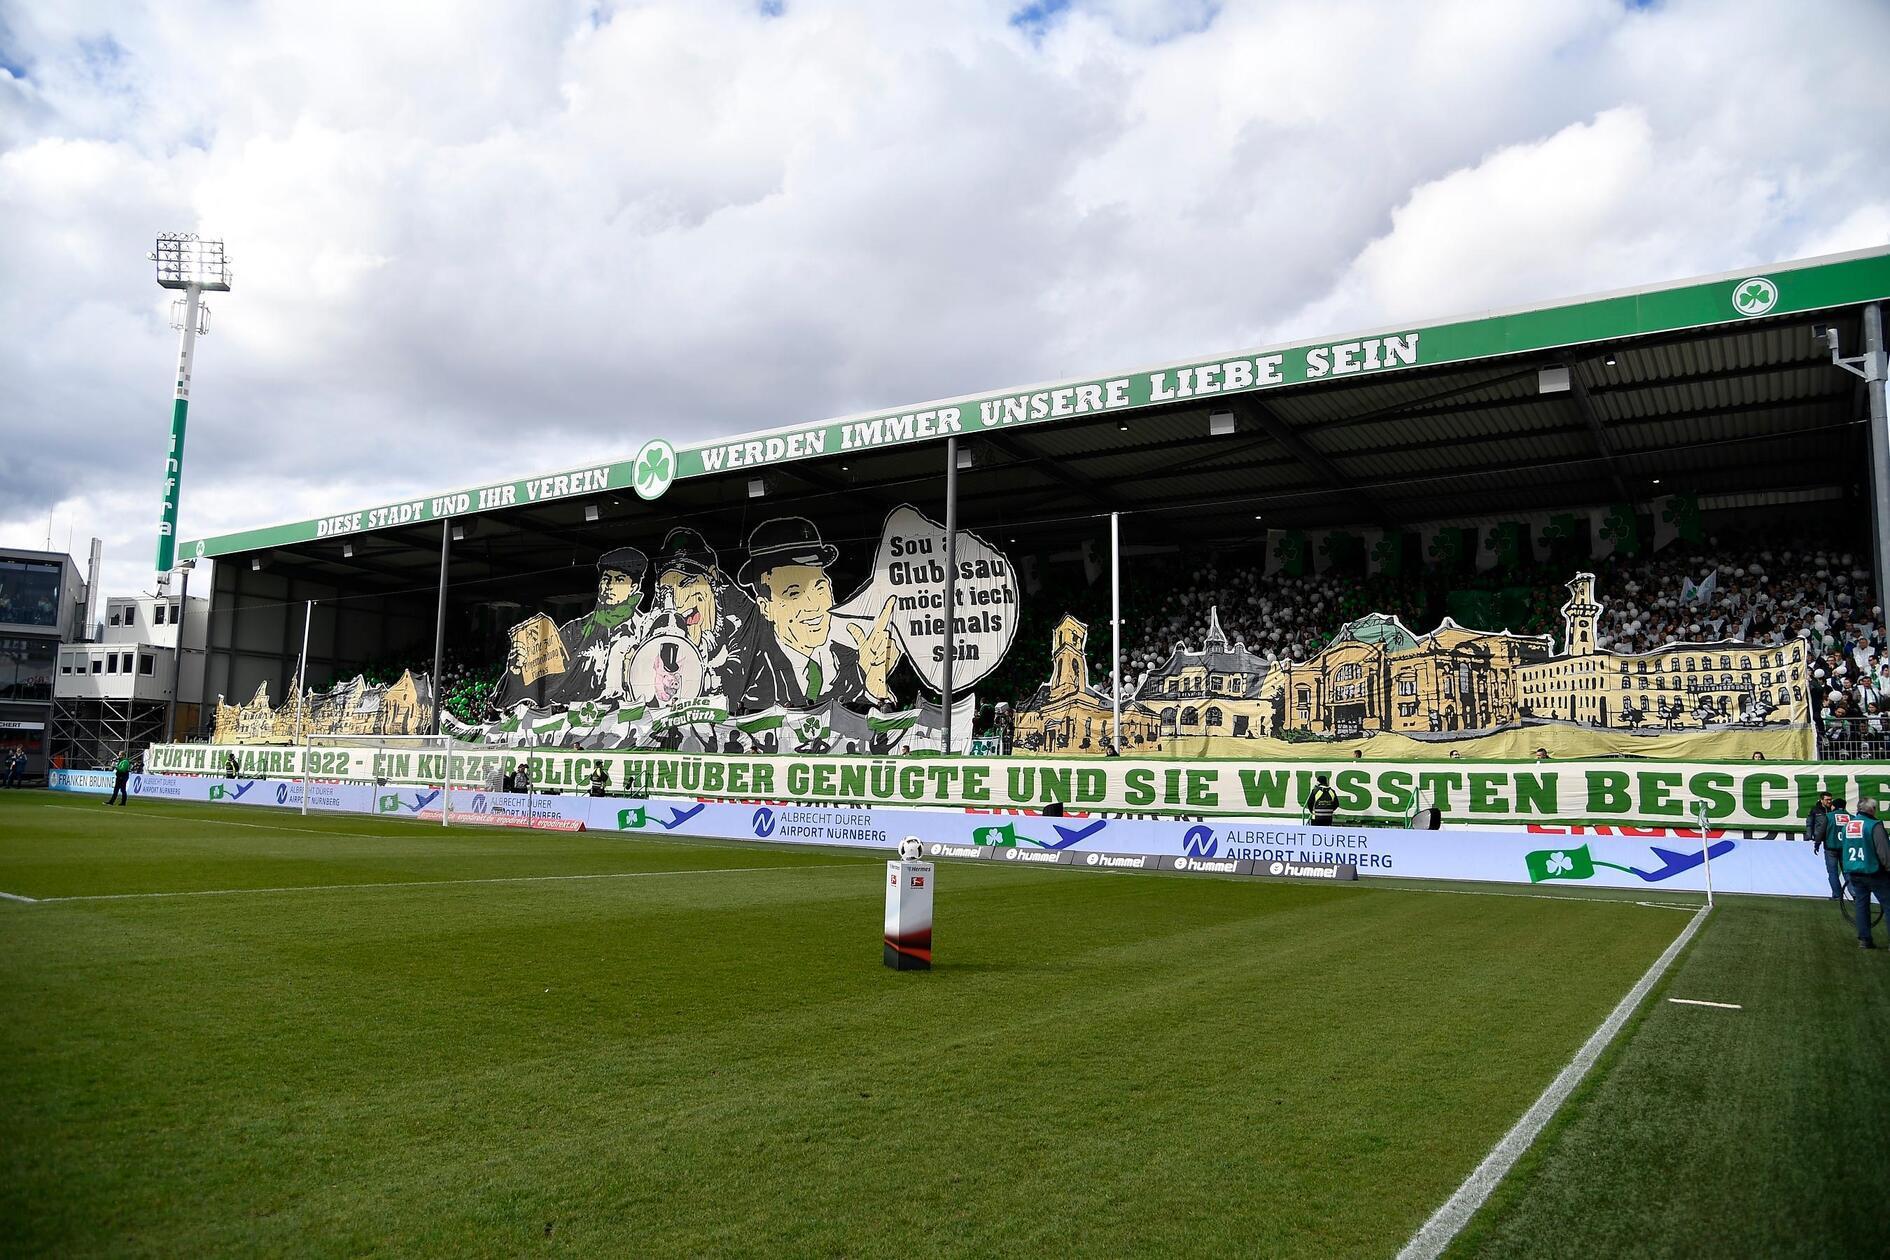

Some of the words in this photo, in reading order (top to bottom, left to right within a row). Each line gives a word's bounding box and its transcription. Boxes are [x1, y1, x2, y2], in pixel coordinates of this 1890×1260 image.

[316, 513, 362, 538] DIESE
[367, 501, 424, 529] STADT
[431, 493, 471, 518] UND
[477, 485, 517, 511] IHR
[525, 467, 610, 502] VEREIN
[700, 430, 827, 473] WERDEN
[840, 407, 962, 450] IMMER
[979, 378, 1131, 427] UNSERE
[1149, 353, 1284, 402] LIEBE
[1305, 333, 1420, 379] SEIN
[159, 434, 179, 536] infra
[890, 536, 933, 557] Sou
[888, 559, 1006, 586] Glubsau
[898, 587, 964, 611] möct
[969, 583, 1014, 606] iech
[910, 611, 1003, 636] niemals
[57, 774, 88, 786] FRANKEN
[89, 775, 116, 788] BRUNNE
[153, 745, 207, 769] FÜRTH
[238, 750, 296, 773] JAHRE
[301, 750, 350, 775] 1922
[372, 753, 411, 777] EIN
[417, 753, 517, 781] KURZER
[623, 756, 774, 793] HINÜBER
[787, 760, 990, 801] GENÜGTE
[1007, 765, 1107, 803] UND
[1124, 768, 1219, 807] SIE
[1238, 769, 1559, 814] WUSSTEN
[289, 795, 311, 804] AIRPOT
[537, 820, 580, 830] ergodirekt.de
[780, 811, 832, 824] ALBRECHT
[779, 826, 824, 839] AIRPORT
[827, 828, 887, 842] NÜRNBERG
[1226, 830, 1307, 846] ALBRECHT
[1312, 833, 1368, 849] DÜRER
[941, 844, 982, 858] hummel
[1016, 848, 1060, 863] hummel
[1226, 848, 1295, 862] AIRPORT
[1300, 850, 1393, 869] NÜRNBERG
[1848, 847, 1865, 861] 24
[1099, 853, 1146, 868] hummel
[1187, 858, 1237, 873] hummel
[1284, 864, 1338, 879] hummel
